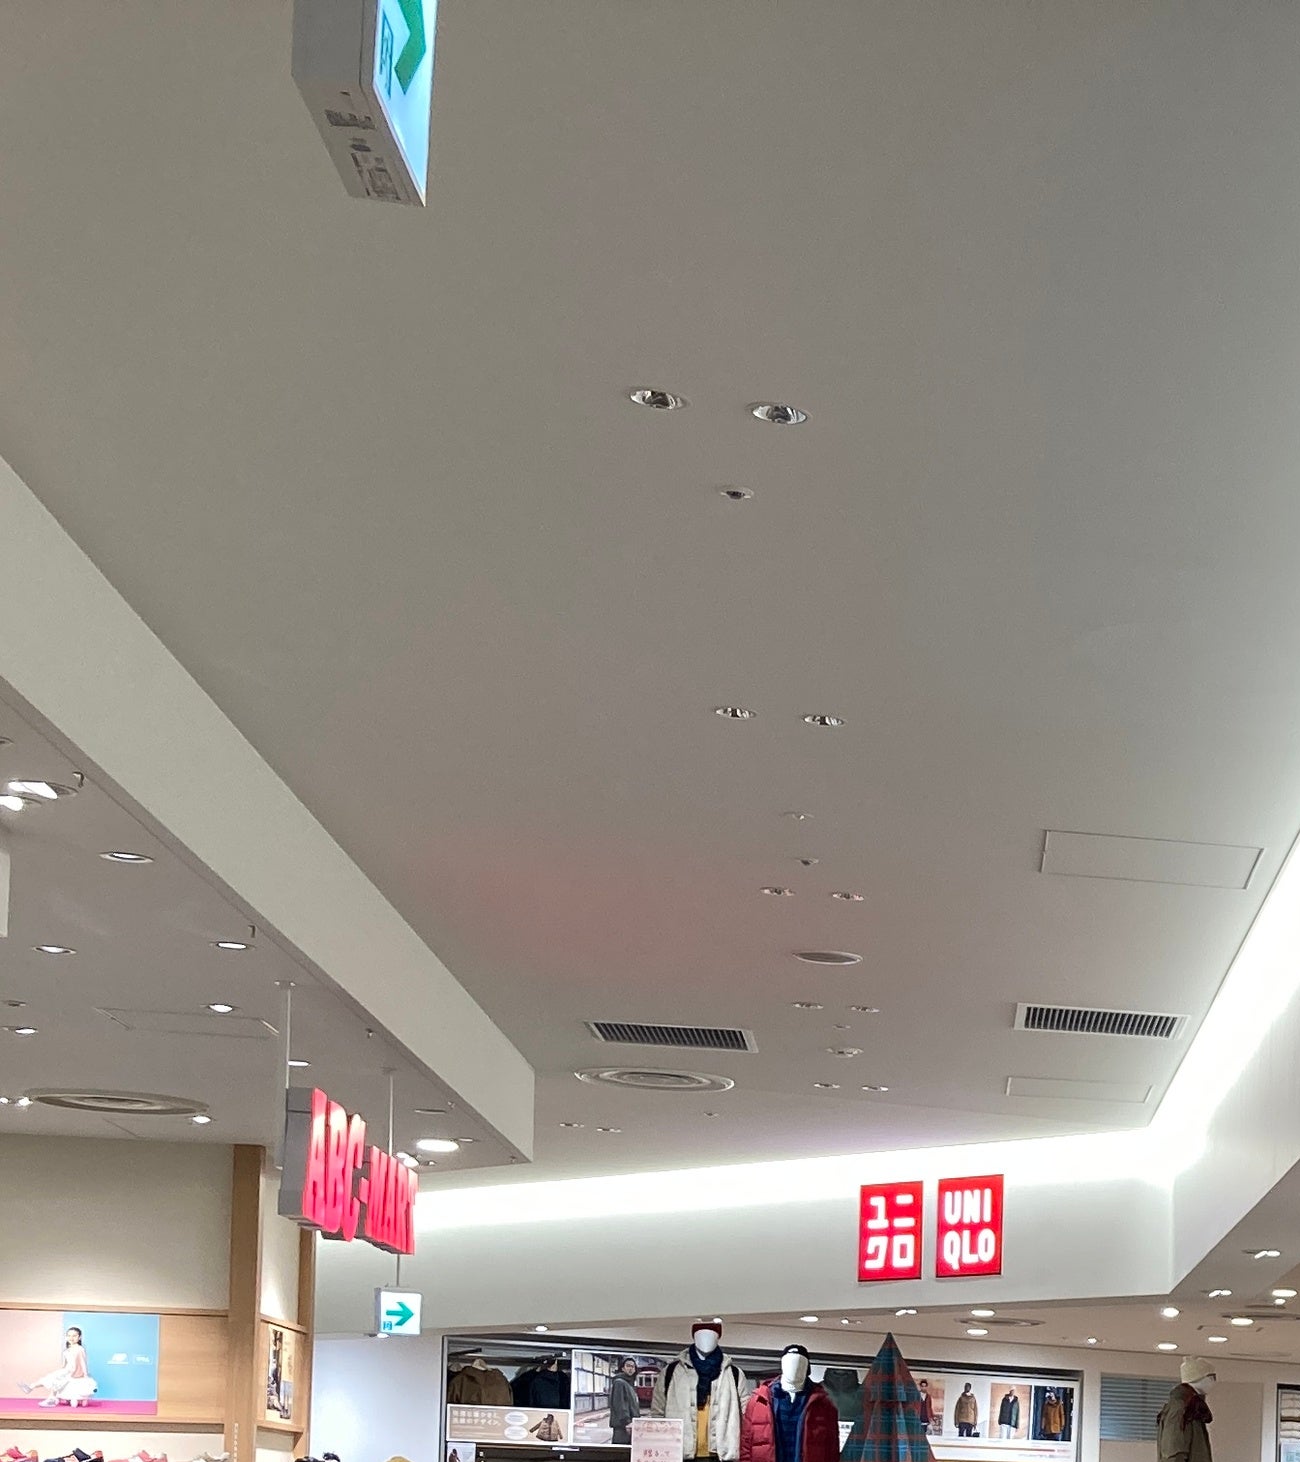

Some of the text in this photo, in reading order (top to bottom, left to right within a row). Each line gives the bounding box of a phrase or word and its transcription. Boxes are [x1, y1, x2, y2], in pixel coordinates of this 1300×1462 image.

[302, 1087, 419, 1256] ABC-MART
[944, 1187, 993, 1226] UNI
[943, 1228, 996, 1271] QLO
